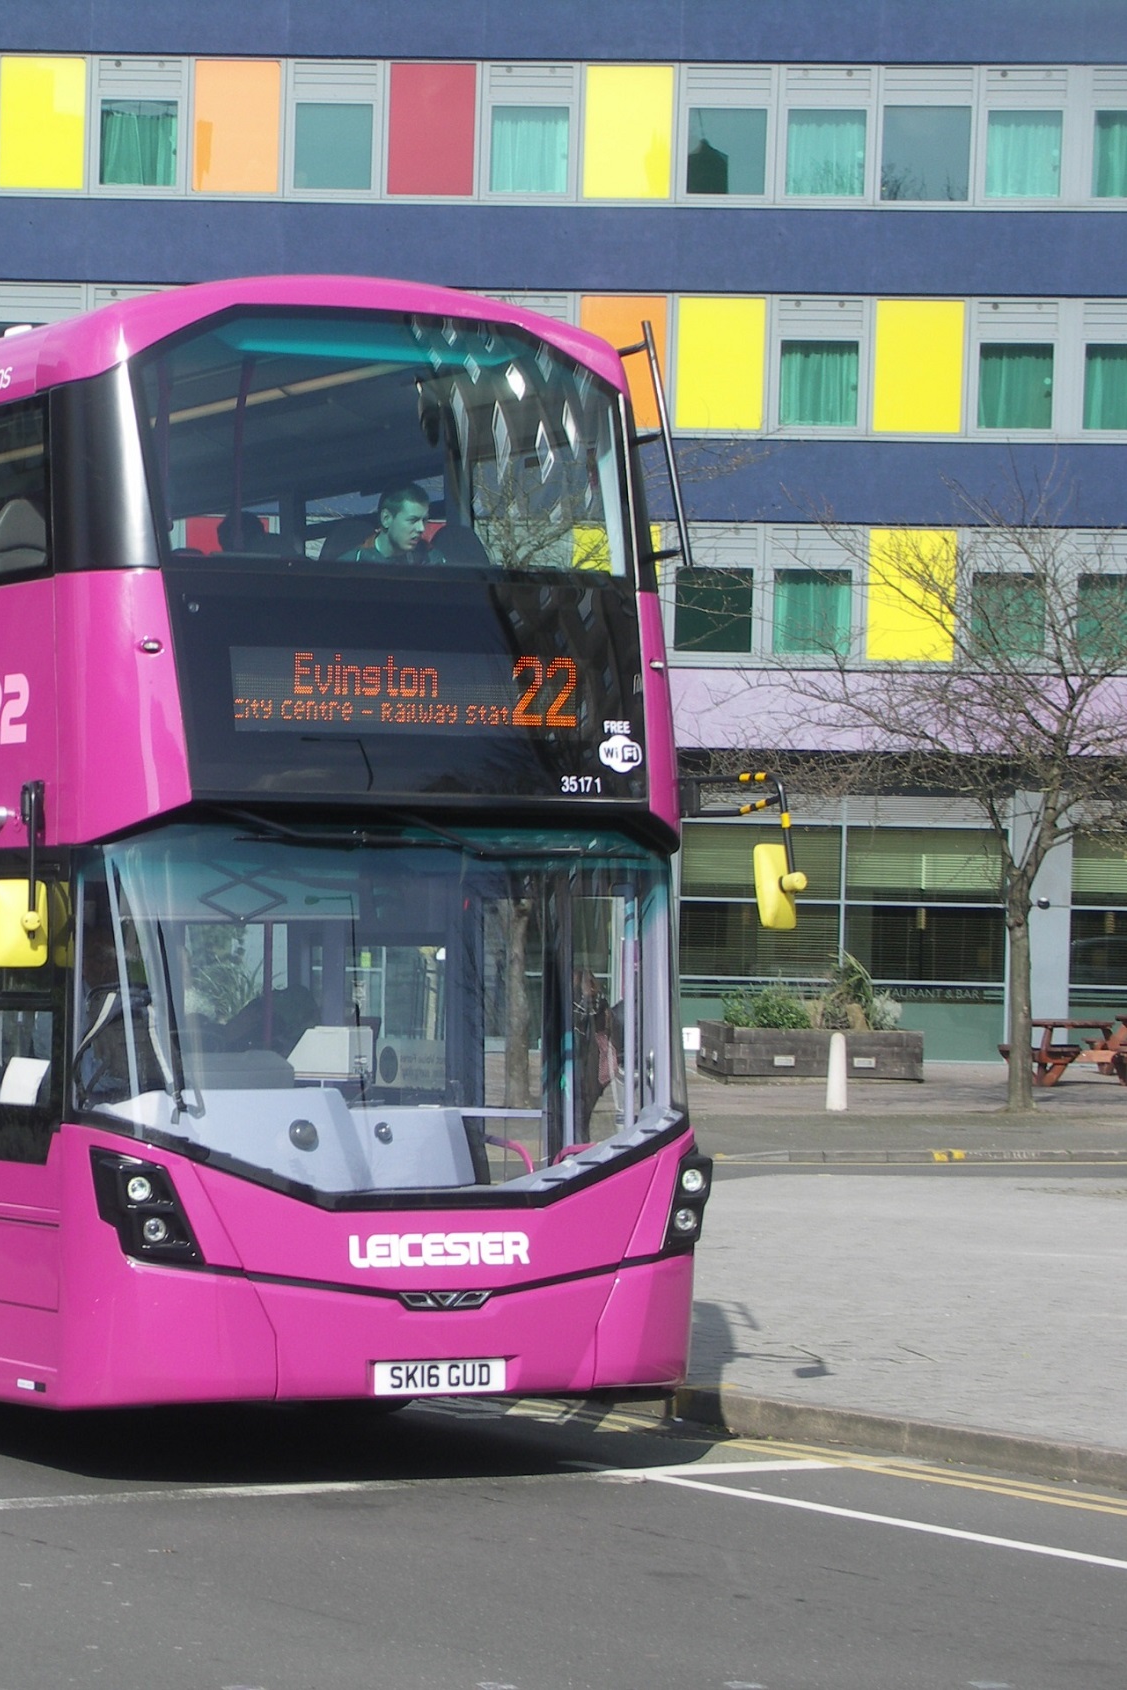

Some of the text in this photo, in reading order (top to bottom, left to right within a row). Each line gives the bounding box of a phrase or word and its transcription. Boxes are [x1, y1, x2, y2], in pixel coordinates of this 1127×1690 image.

[293, 652, 439, 698] Evington
[511, 655, 578, 728] 22
[603, 720, 631, 734] FREE
[560, 775, 602, 794] 35171
[945, 989, 954, 999] &
[955, 989, 981, 1000] BAR
[348, 1231, 531, 1269] LEICESTER
[390, 1362, 491, 1390] SK16 GUD
